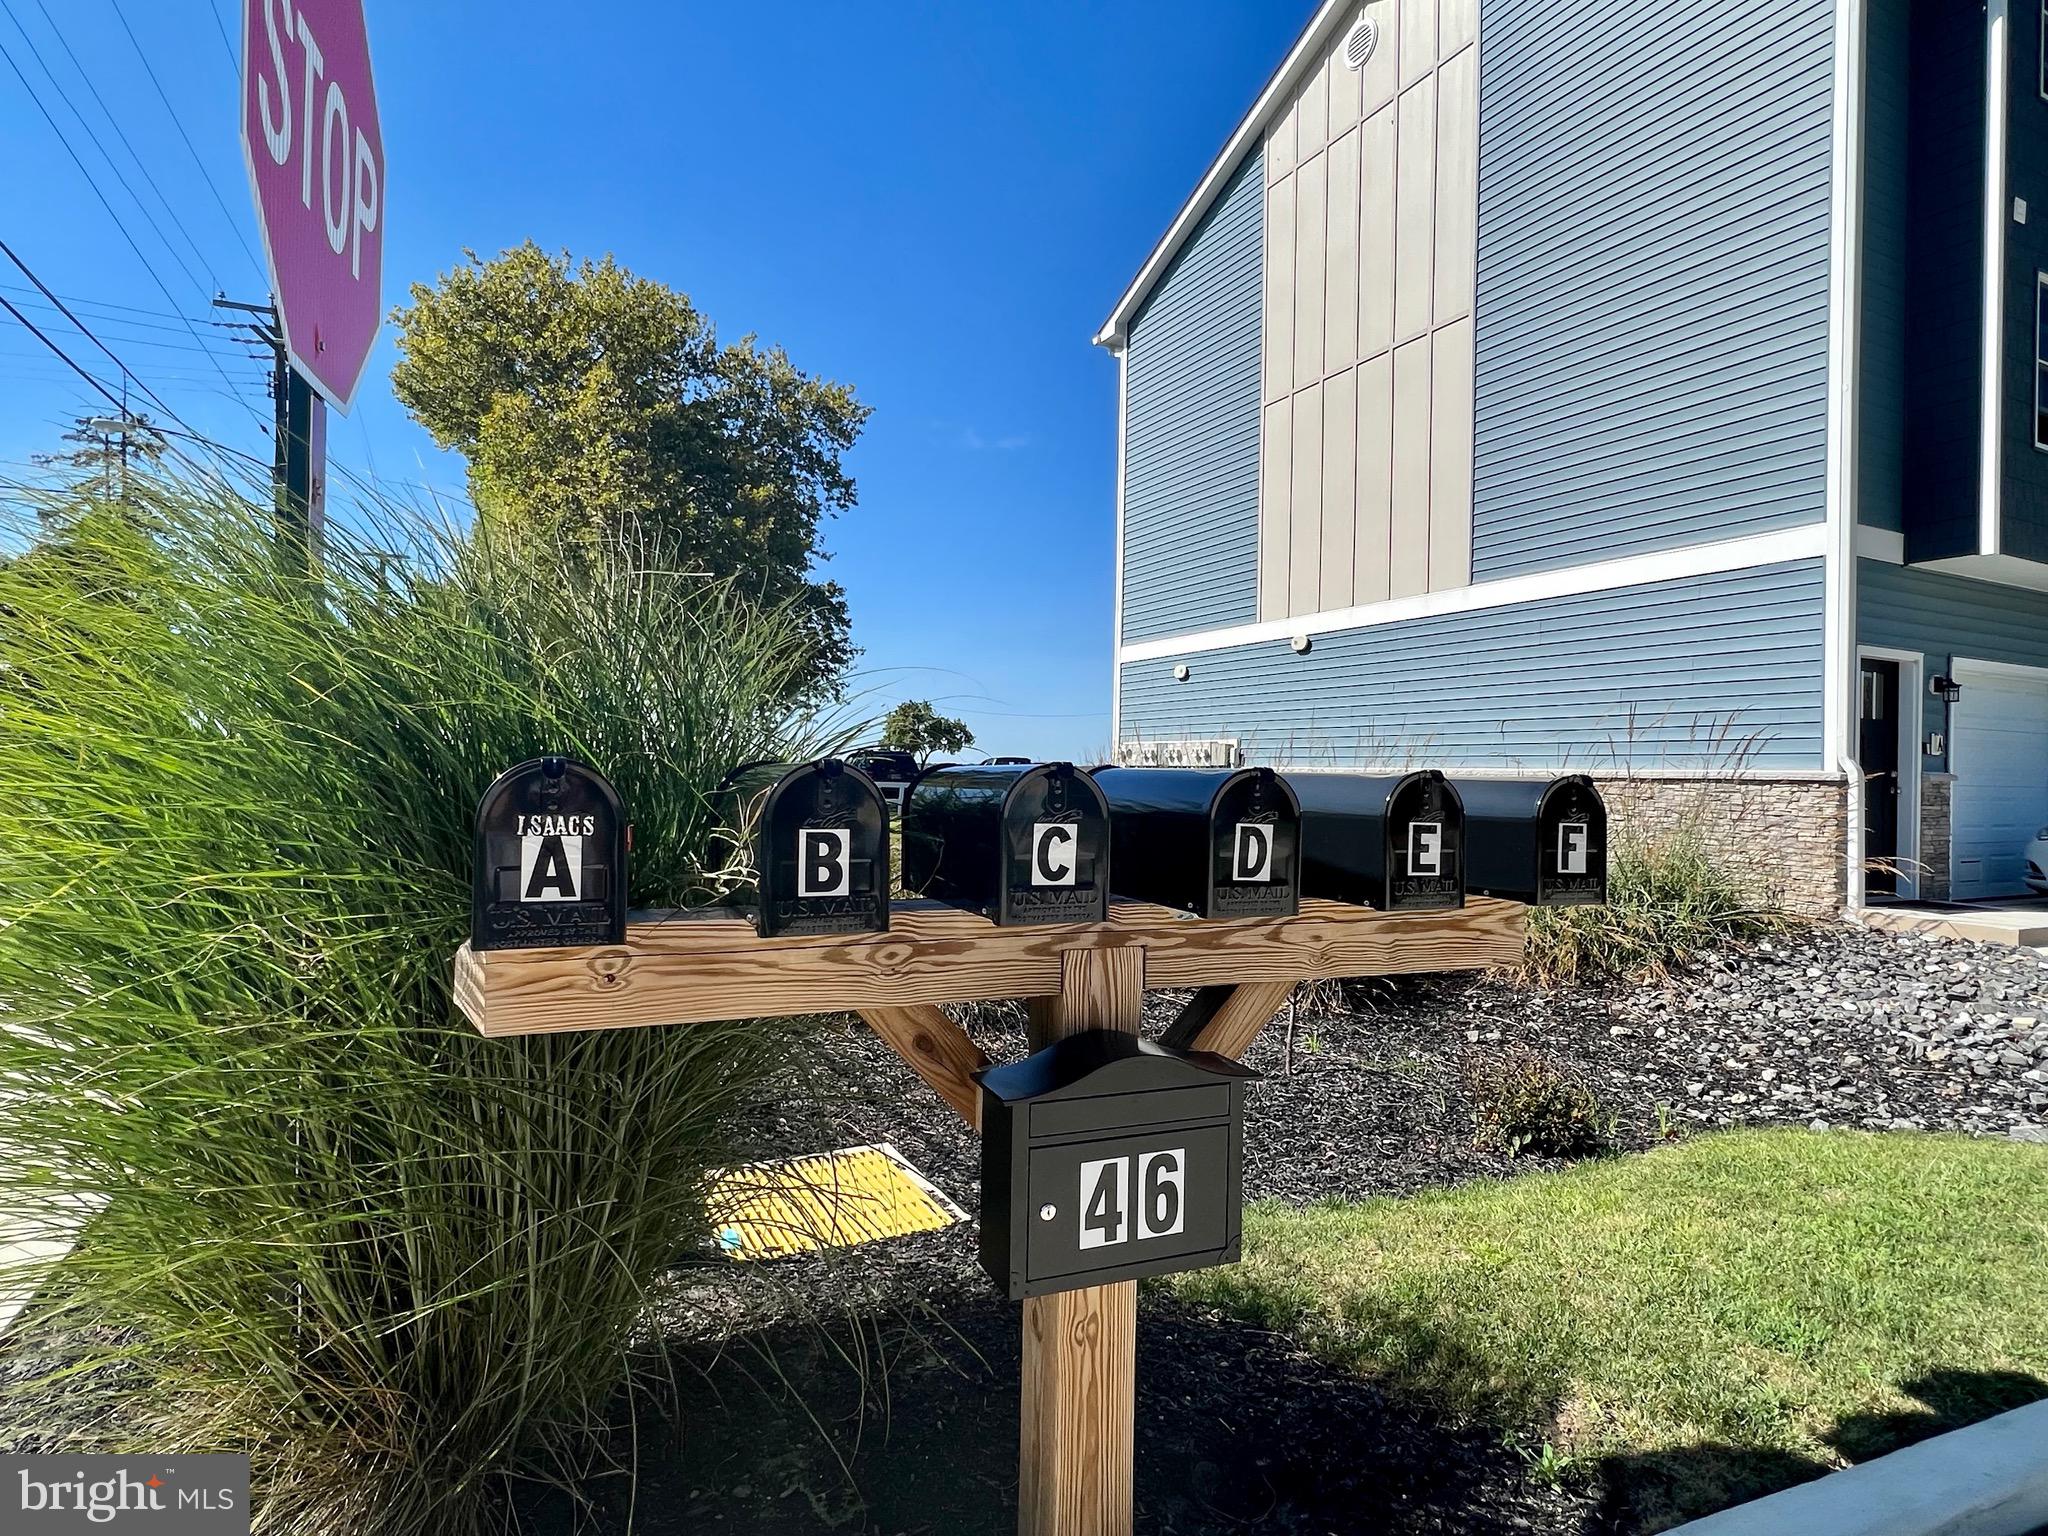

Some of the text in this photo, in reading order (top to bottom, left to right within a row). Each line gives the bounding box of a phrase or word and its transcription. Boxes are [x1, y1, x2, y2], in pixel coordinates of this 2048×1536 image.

[258, 0, 378, 281] STOP
[516, 814, 595, 837] ISAACS
[1411, 824, 1438, 873] E
[1561, 825, 1584, 871] F
[525, 836, 576, 898] A
[804, 831, 843, 893] B
[1037, 826, 1072, 881] C
[1237, 827, 1268, 878] D
[1051, 889, 1097, 905] MAIL
[1247, 886, 1290, 900] MAIL
[1084, 1153, 1178, 1242] 46
